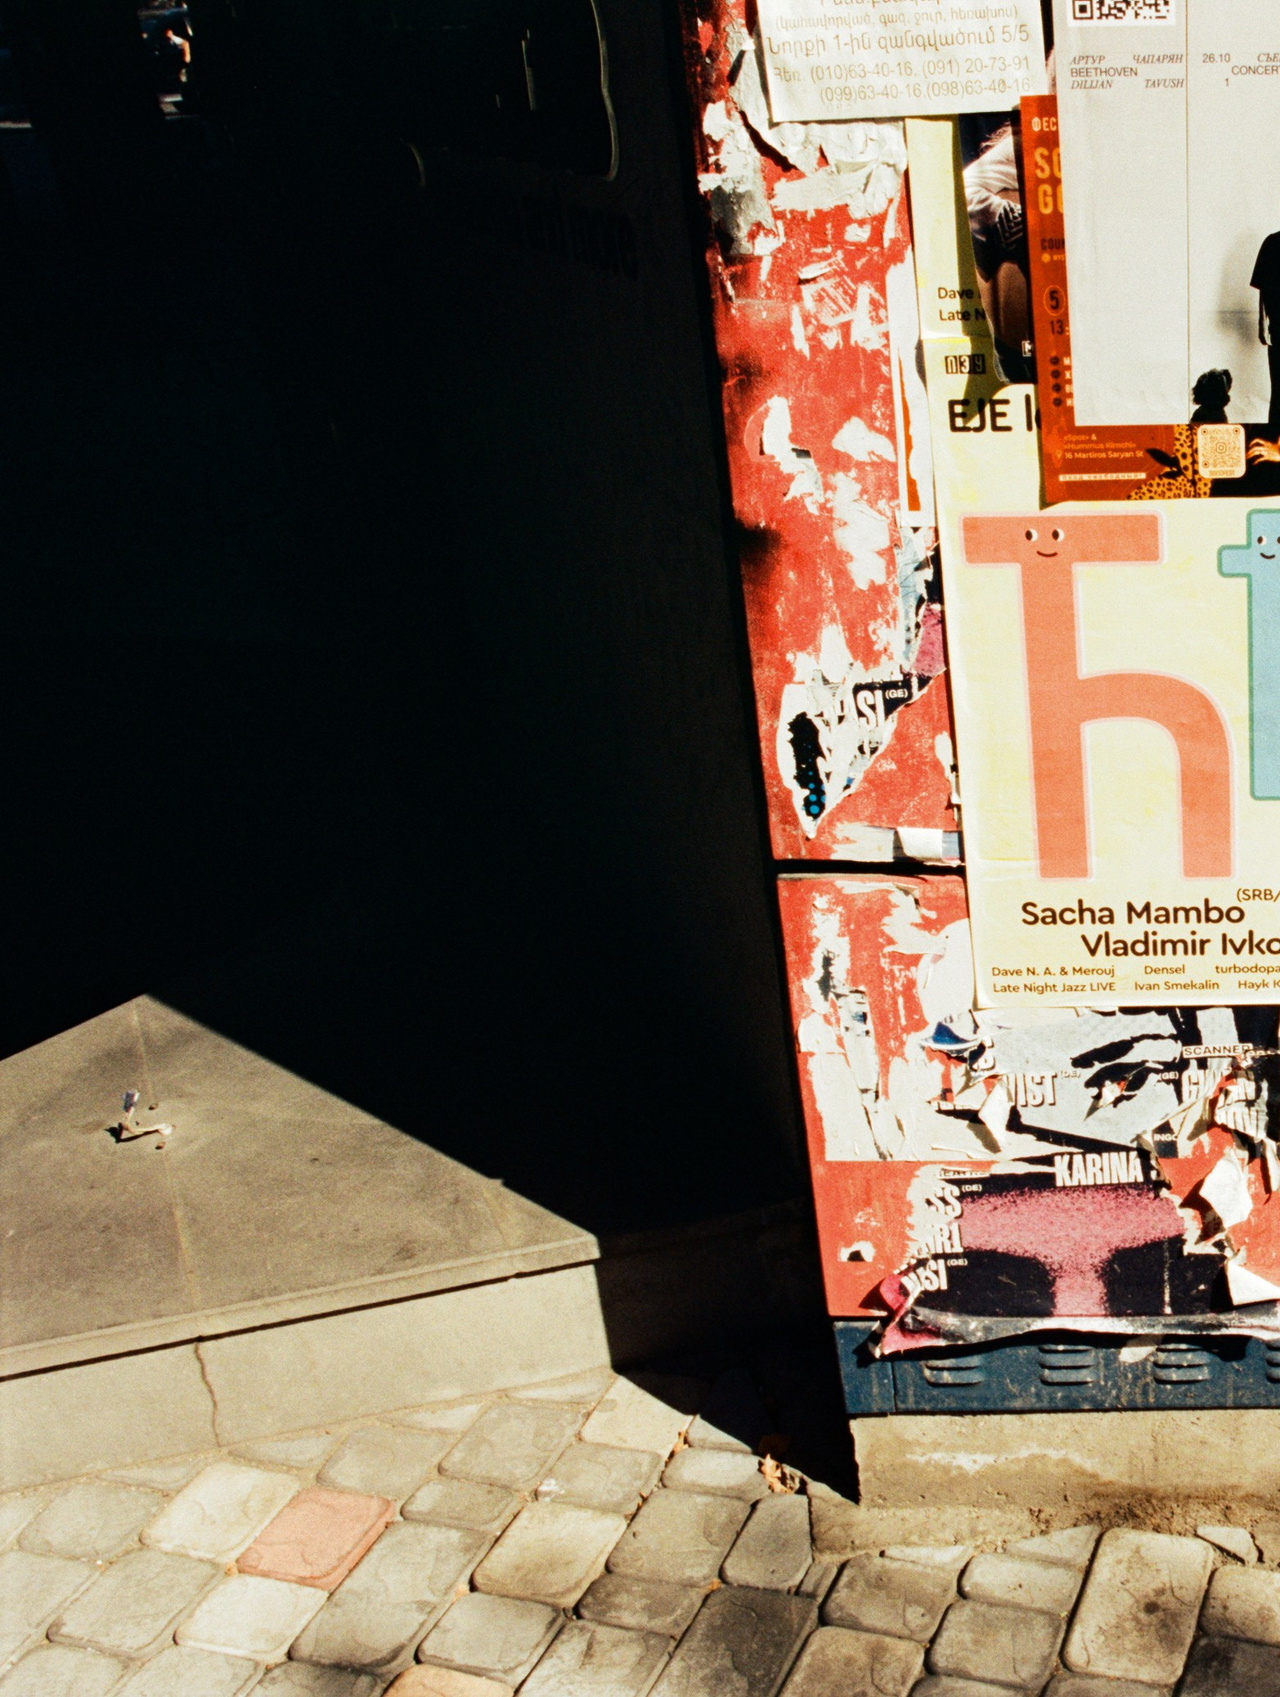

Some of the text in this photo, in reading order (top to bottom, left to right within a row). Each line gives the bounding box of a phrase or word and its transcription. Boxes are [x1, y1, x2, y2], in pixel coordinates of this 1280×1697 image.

[1002, 24, 1030, 44] 5/5
[1069, 54, 1106, 66] АРТУР
[1132, 53, 1184, 65] ЧАПАРЯН
[1202, 53, 1231, 64] 26.10
[922, 58, 960, 79] (091)
[964, 56, 1031, 74] 20-73-91
[1070, 66, 1138, 78] BEETHOVEN
[1070, 79, 1114, 90] DILIJAN
[1144, 78, 1185, 89] TAVUSH
[1224, 78, 1230, 87] 1
[938, 287, 974, 300] Dave
[1049, 290, 1059, 311] 5
[939, 309, 971, 321] Late
[948, 398, 1013, 433] EJE
[1107, 450, 1134, 460] Saryan
[885, 688, 908, 700] (GE)
[1021, 898, 1115, 925] Sacha
[1126, 897, 1246, 925] Mambo
[1080, 930, 1212, 957] Vladimir
[992, 966, 1023, 977] Dave
[1026, 966, 1040, 977] N.
[1043, 966, 1056, 977] A.
[1059, 966, 1068, 976] &
[1072, 965, 1116, 978] Merouj
[1143, 964, 1186, 975] Densel
[992, 982, 1020, 993] Late
[1023, 981, 1059, 994] Night
[1061, 981, 1087, 992] Jazz
[1089, 981, 1117, 991] LIVE
[1134, 981, 1161, 991] Ivan
[1163, 979, 1220, 991] Smekalin
[1237, 978, 1270, 991] Hayk
[1158, 1071, 1179, 1081] (GE)
[1054, 1151, 1144, 1187] KARINA
[962, 1184, 983, 1193] (DE)
